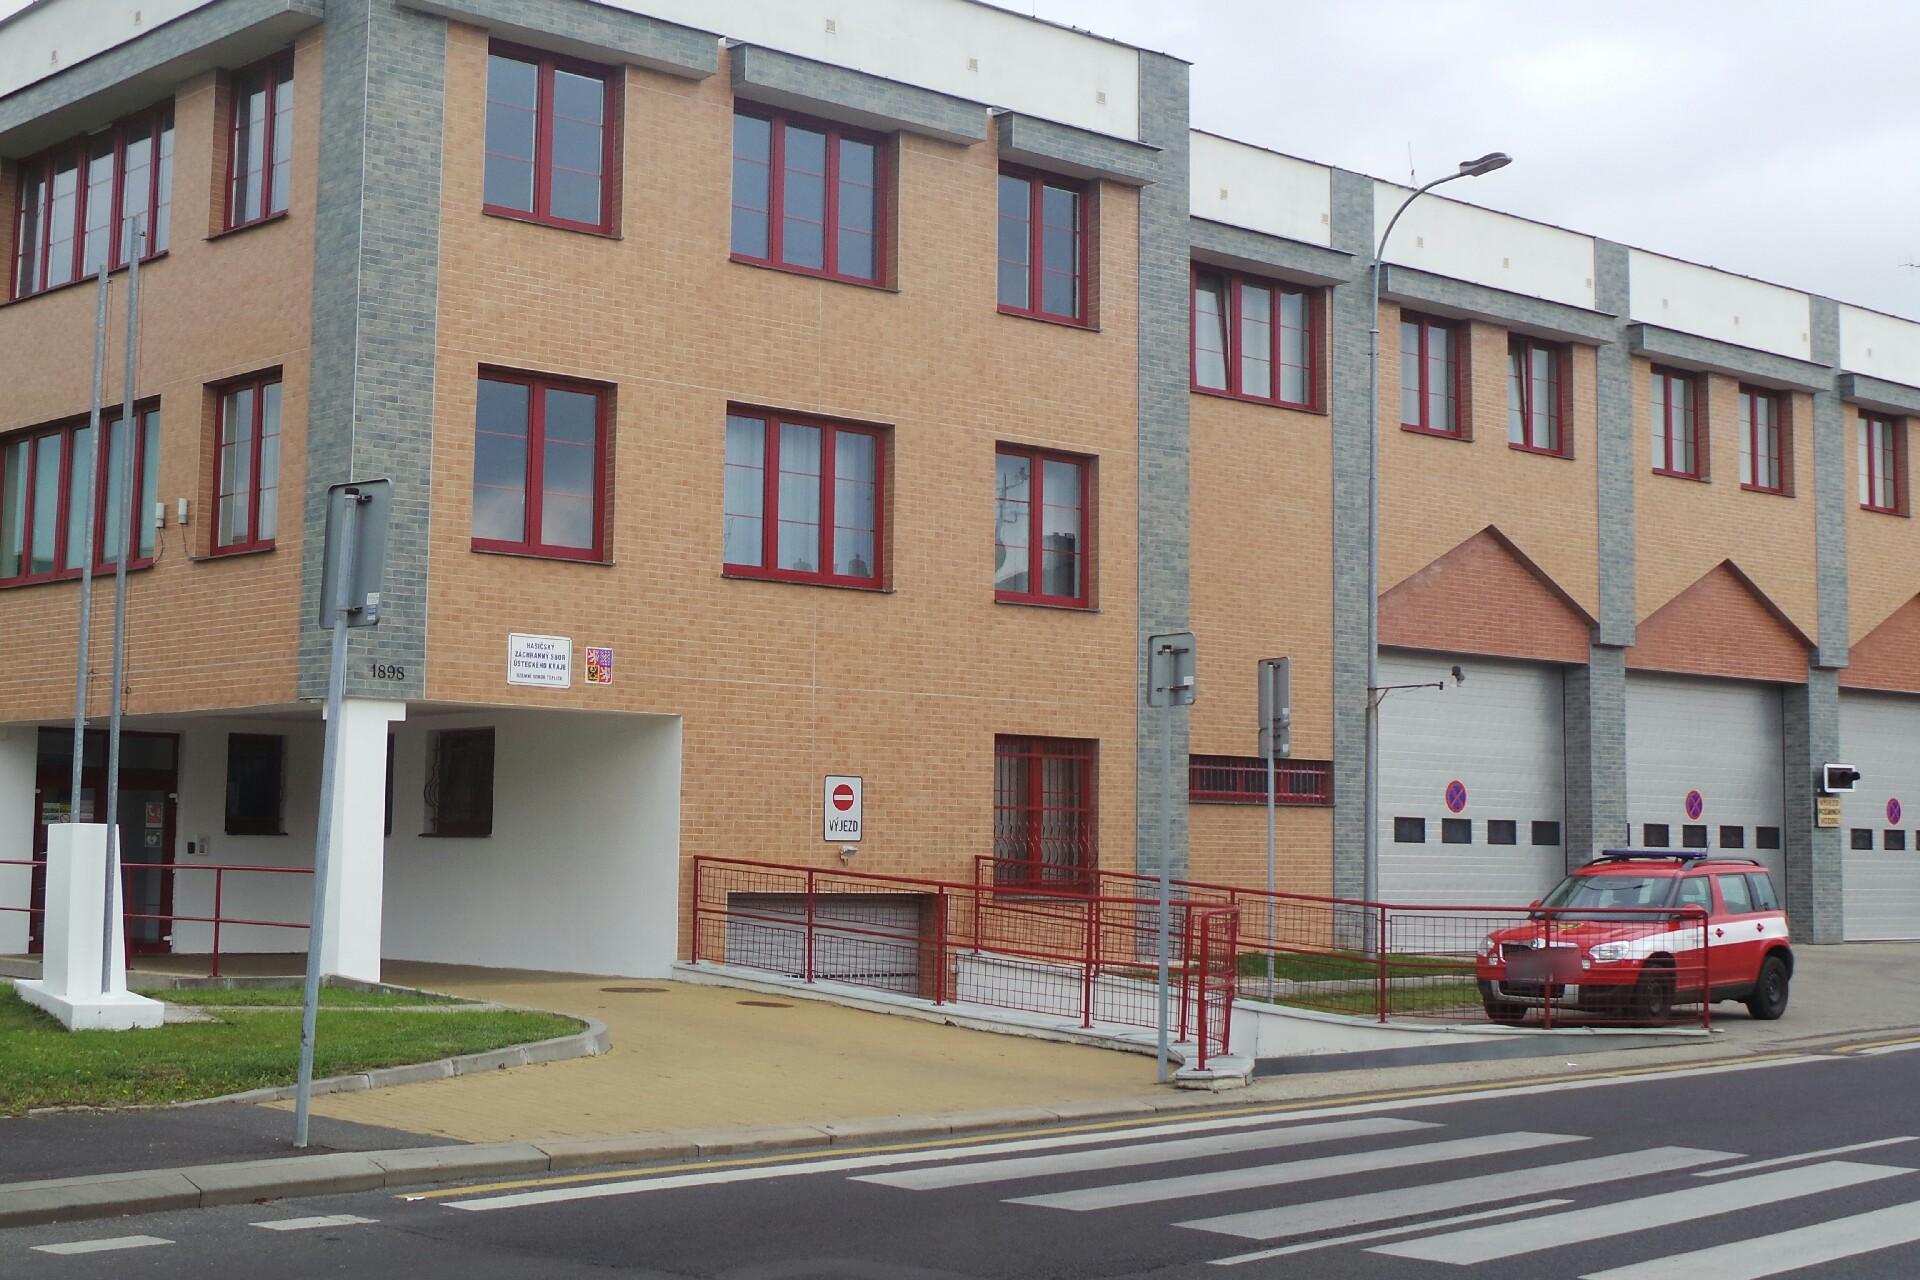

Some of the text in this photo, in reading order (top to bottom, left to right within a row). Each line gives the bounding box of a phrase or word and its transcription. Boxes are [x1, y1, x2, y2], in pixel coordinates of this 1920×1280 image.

[551, 653, 566, 661] SBOR
[373, 664, 405, 680] 1898
[549, 663, 566, 671] KRAJE
[829, 817, 858, 832] VÝJEZD
